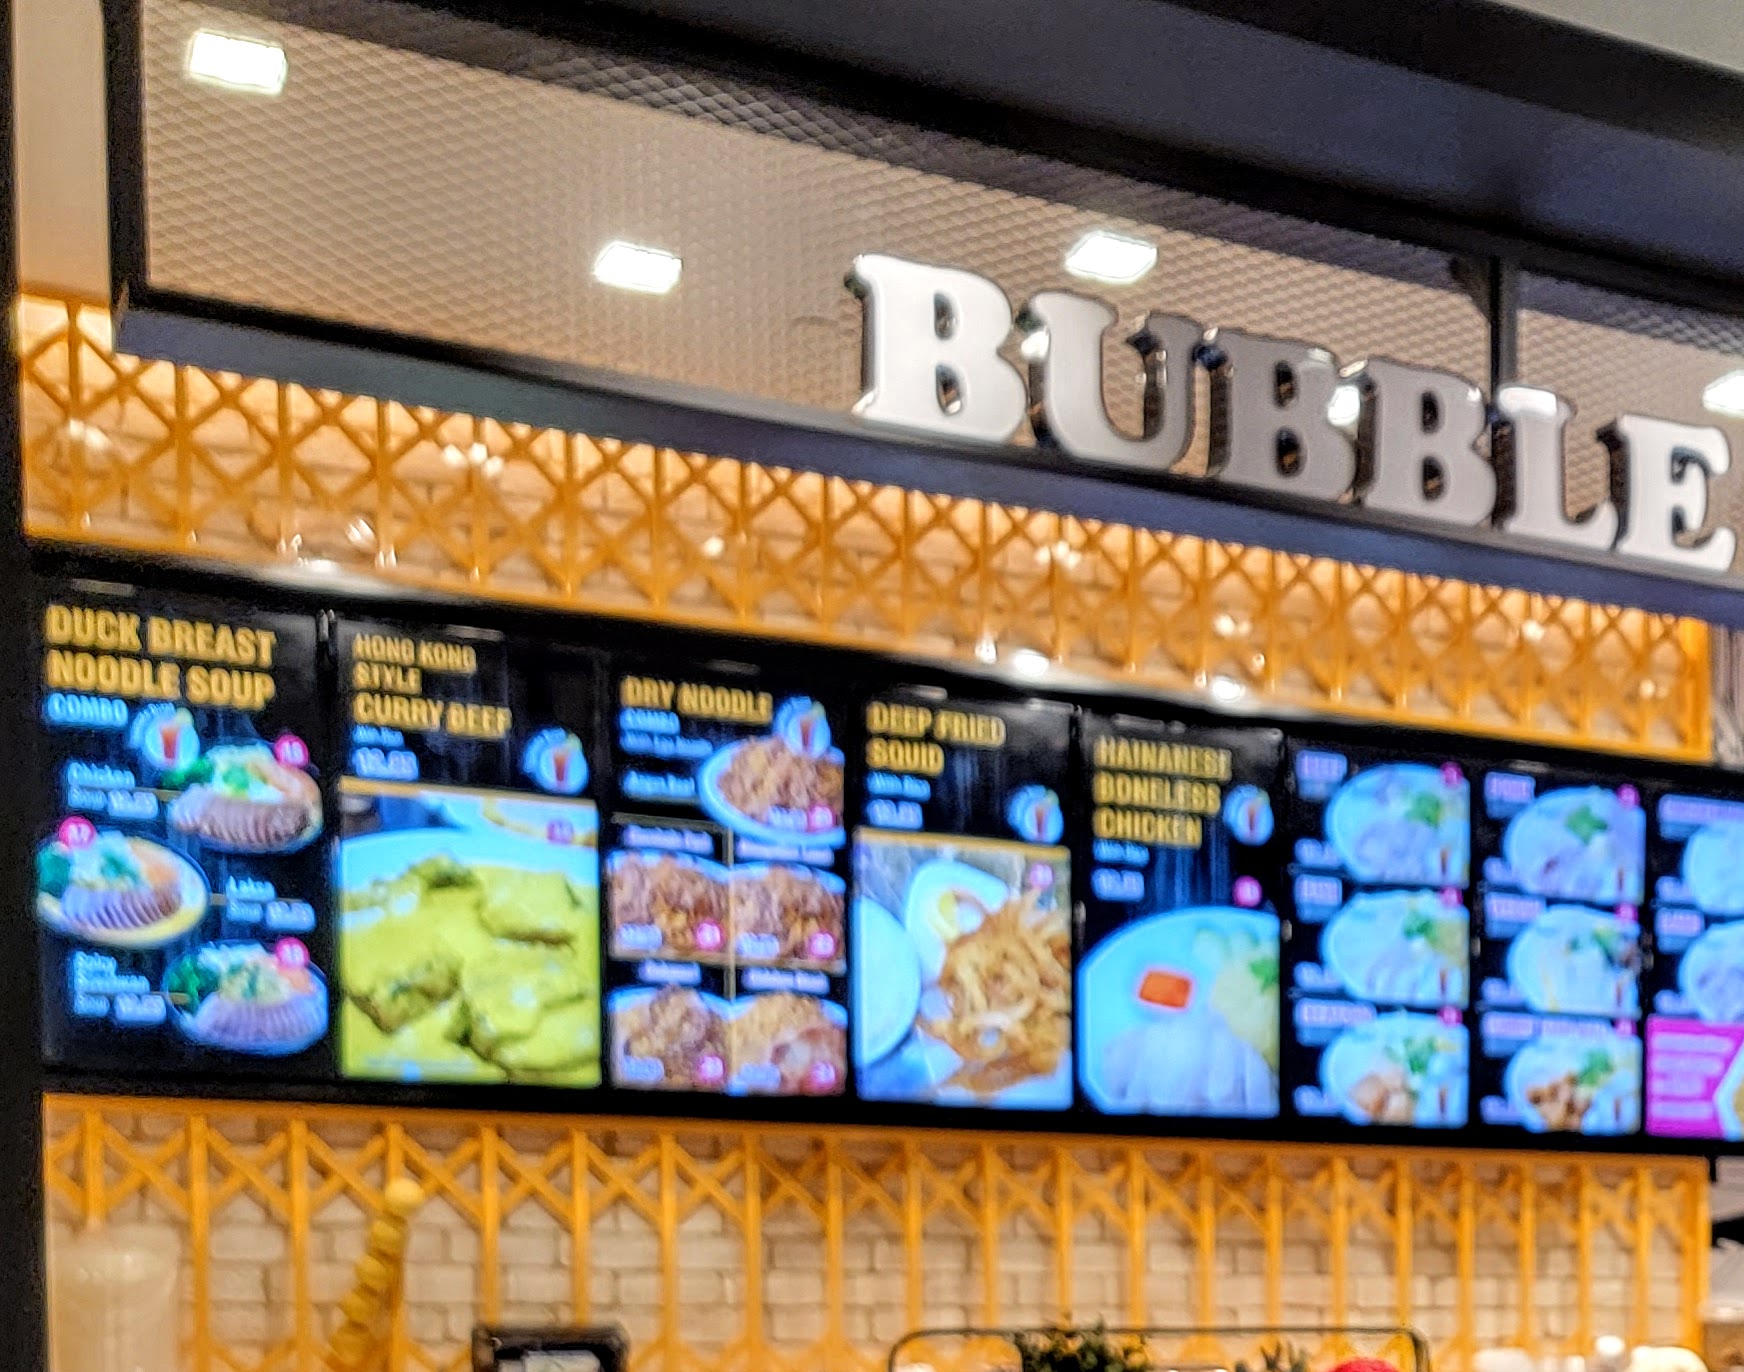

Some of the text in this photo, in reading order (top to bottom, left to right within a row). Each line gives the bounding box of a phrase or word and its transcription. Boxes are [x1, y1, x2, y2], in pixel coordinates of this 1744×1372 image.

[850, 253, 1736, 572] BUBBLE
[46, 604, 276, 669] DUCK BREAST
[352, 633, 476, 674] HONG KONG
[47, 649, 276, 711] NOODLE SOUP
[353, 661, 421, 695] STYLE
[620, 675, 772, 724] DRY NOODLE
[353, 692, 444, 731] CURRY
[446, 702, 511, 738] BEEF
[866, 701, 1006, 748] DEEP FRIED
[866, 737, 944, 777] SQUID
[1093, 734, 1232, 783] HAINANESE
[1093, 770, 1221, 817] BONELESS
[1093, 805, 1202, 849] CHICKEN
